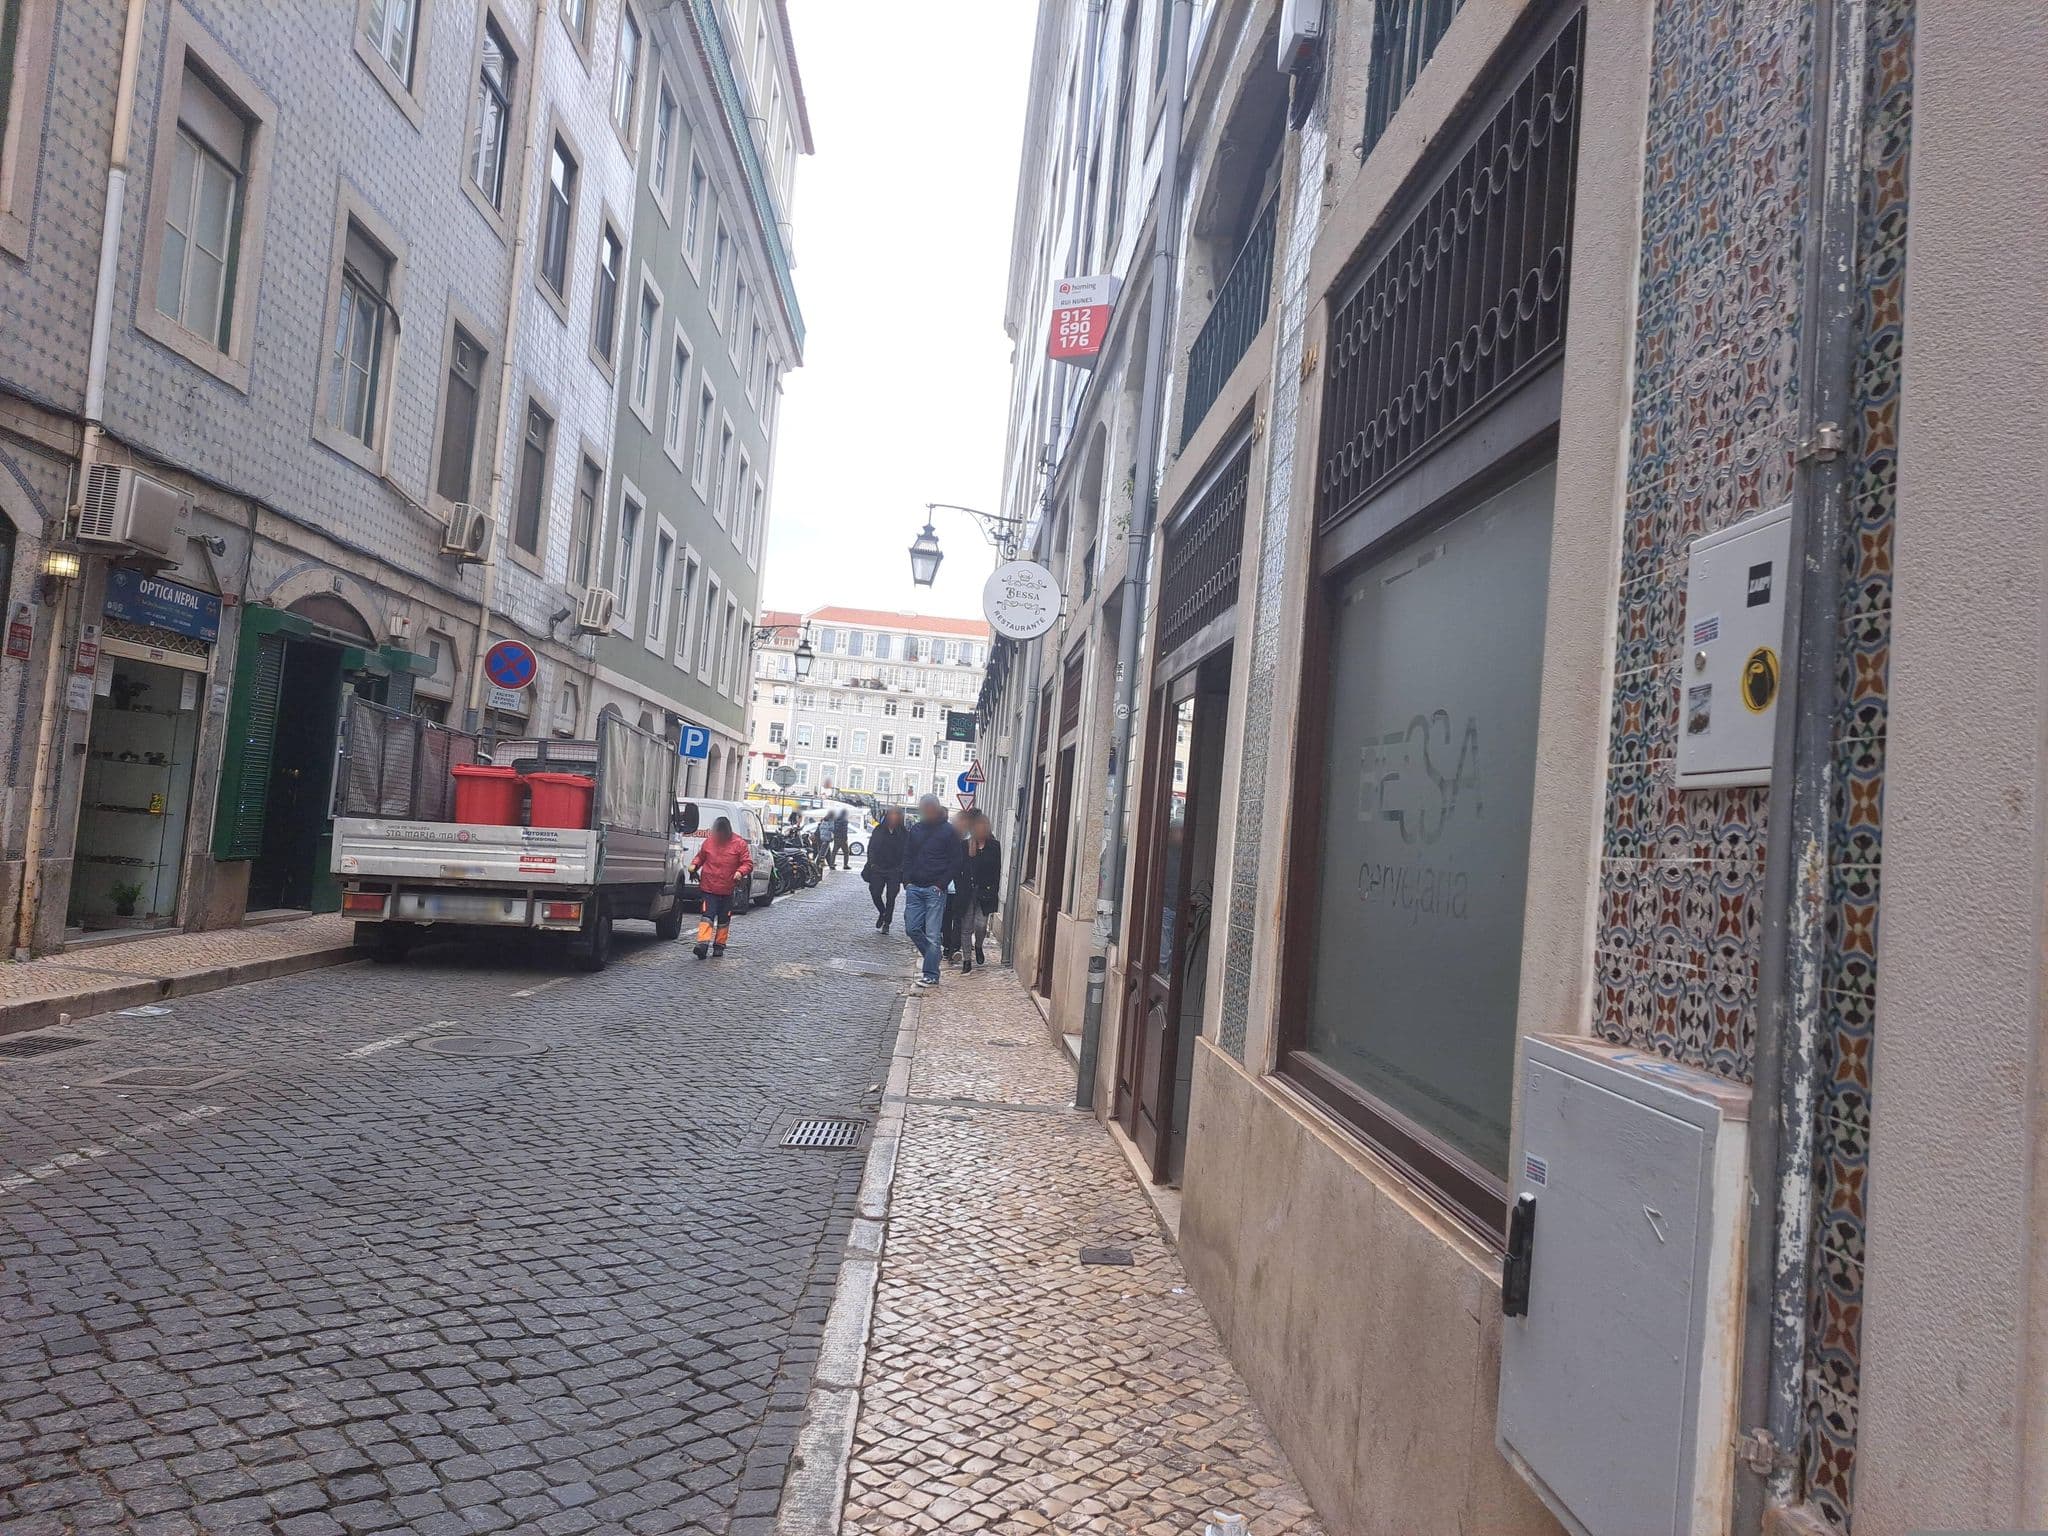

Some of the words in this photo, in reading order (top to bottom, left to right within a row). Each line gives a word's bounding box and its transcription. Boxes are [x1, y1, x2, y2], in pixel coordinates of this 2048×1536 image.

[1061, 309, 1091, 323] 912
[1060, 321, 1090, 335] 690
[1060, 334, 1089, 348] 176
[139, 579, 173, 603] OPTICA
[174, 590, 200, 609] NEPAL
[1005, 586, 1040, 601] BESSA
[993, 610, 1046, 632] RESTAURANTE
[685, 728, 704, 755] P
